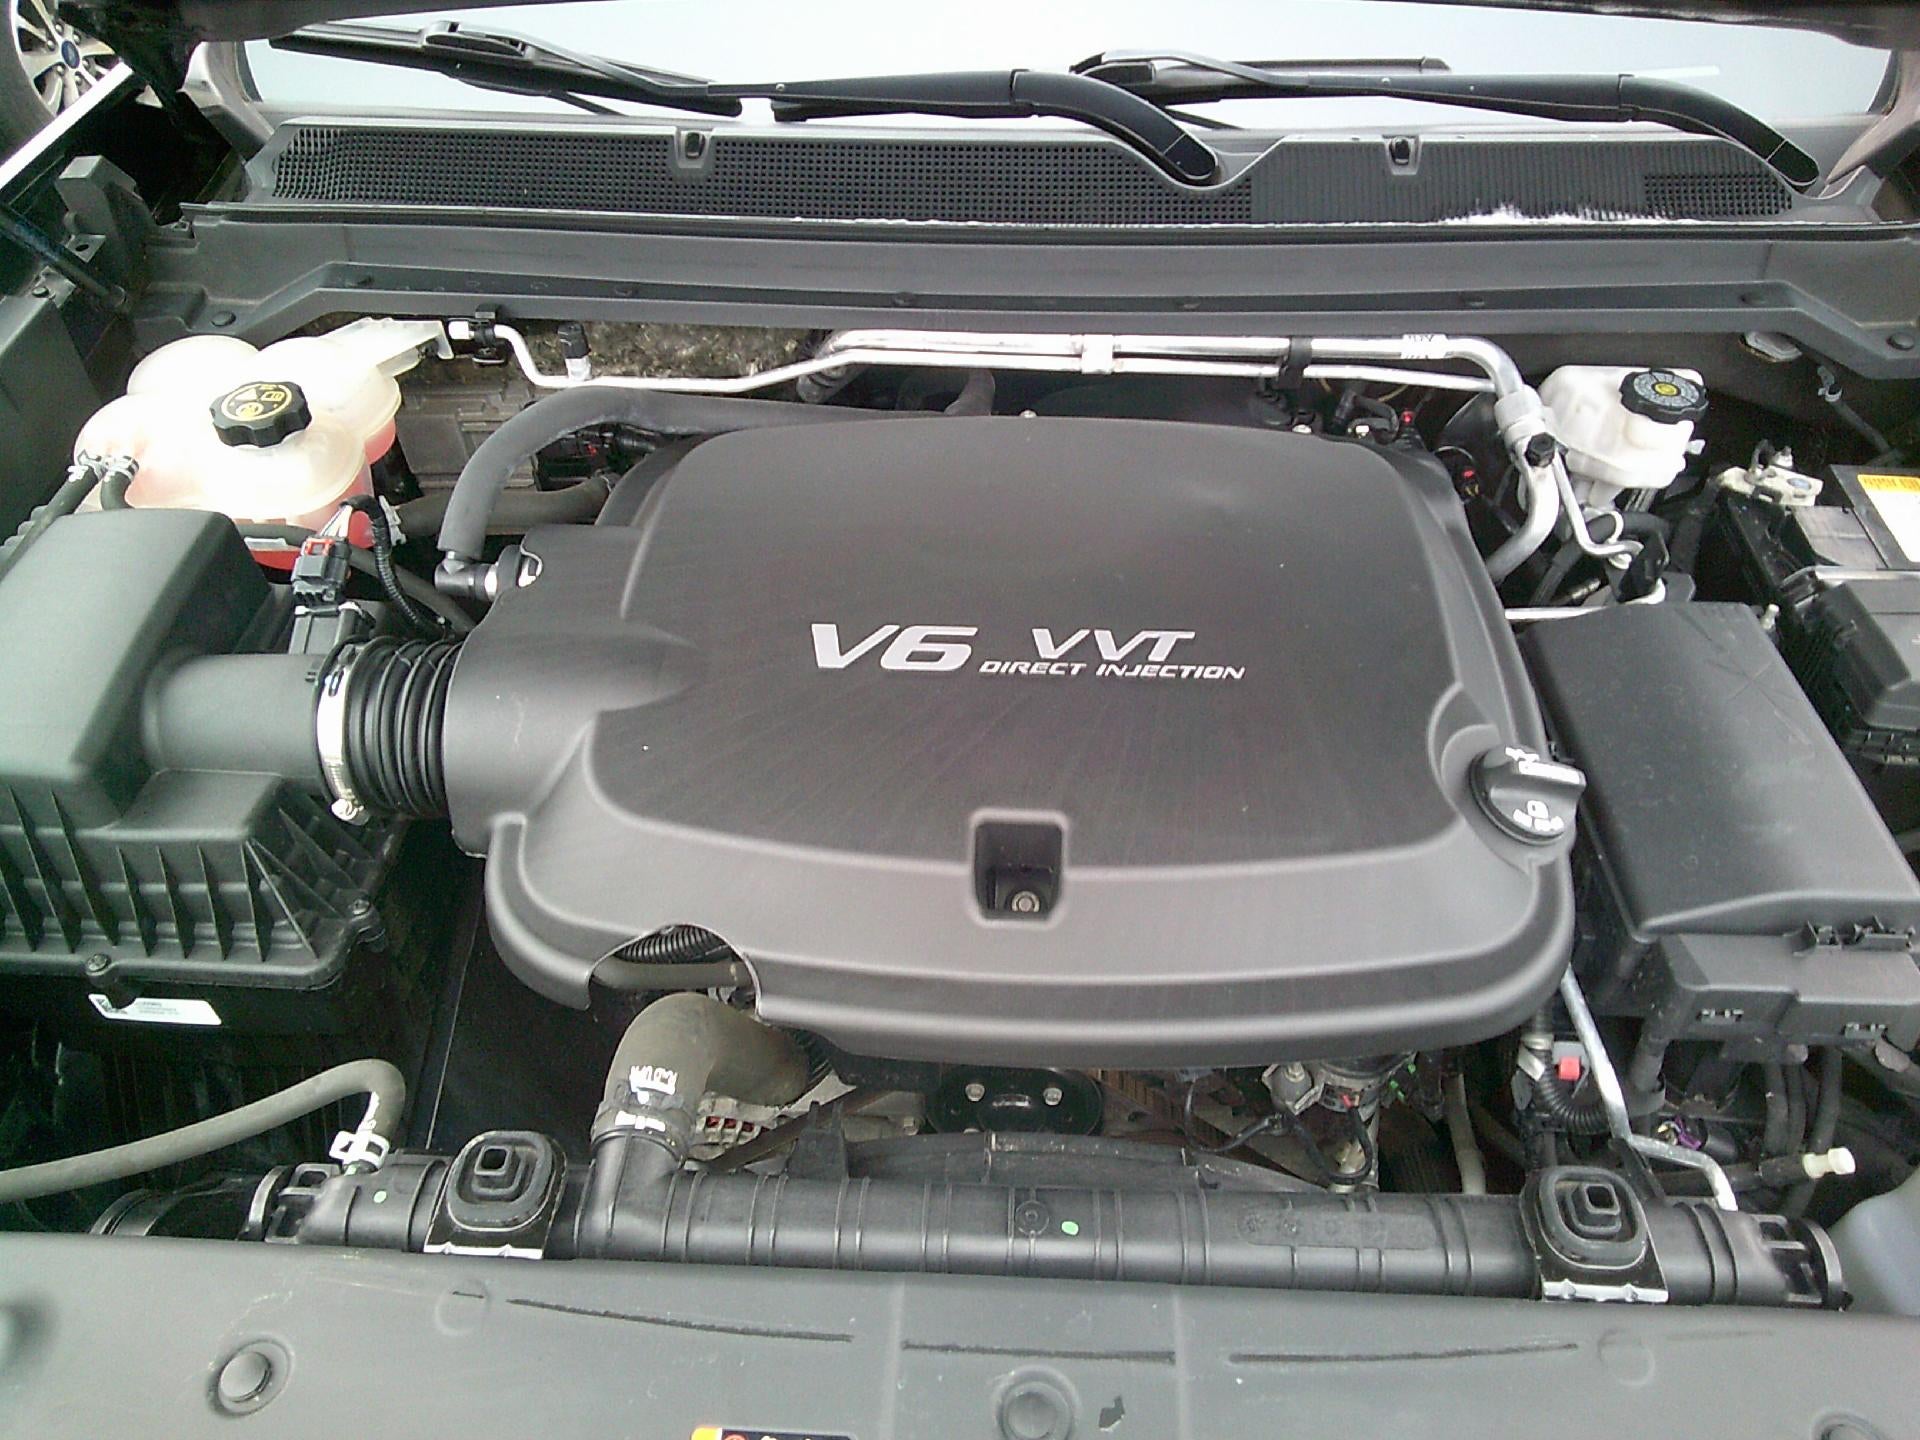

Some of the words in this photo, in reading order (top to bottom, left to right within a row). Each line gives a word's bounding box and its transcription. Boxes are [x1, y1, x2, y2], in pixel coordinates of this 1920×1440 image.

[811, 623, 979, 671] V6
[1031, 628, 1196, 662] VVT
[978, 660, 1087, 676] DIRECT
[1095, 663, 1247, 680] INJECTION
